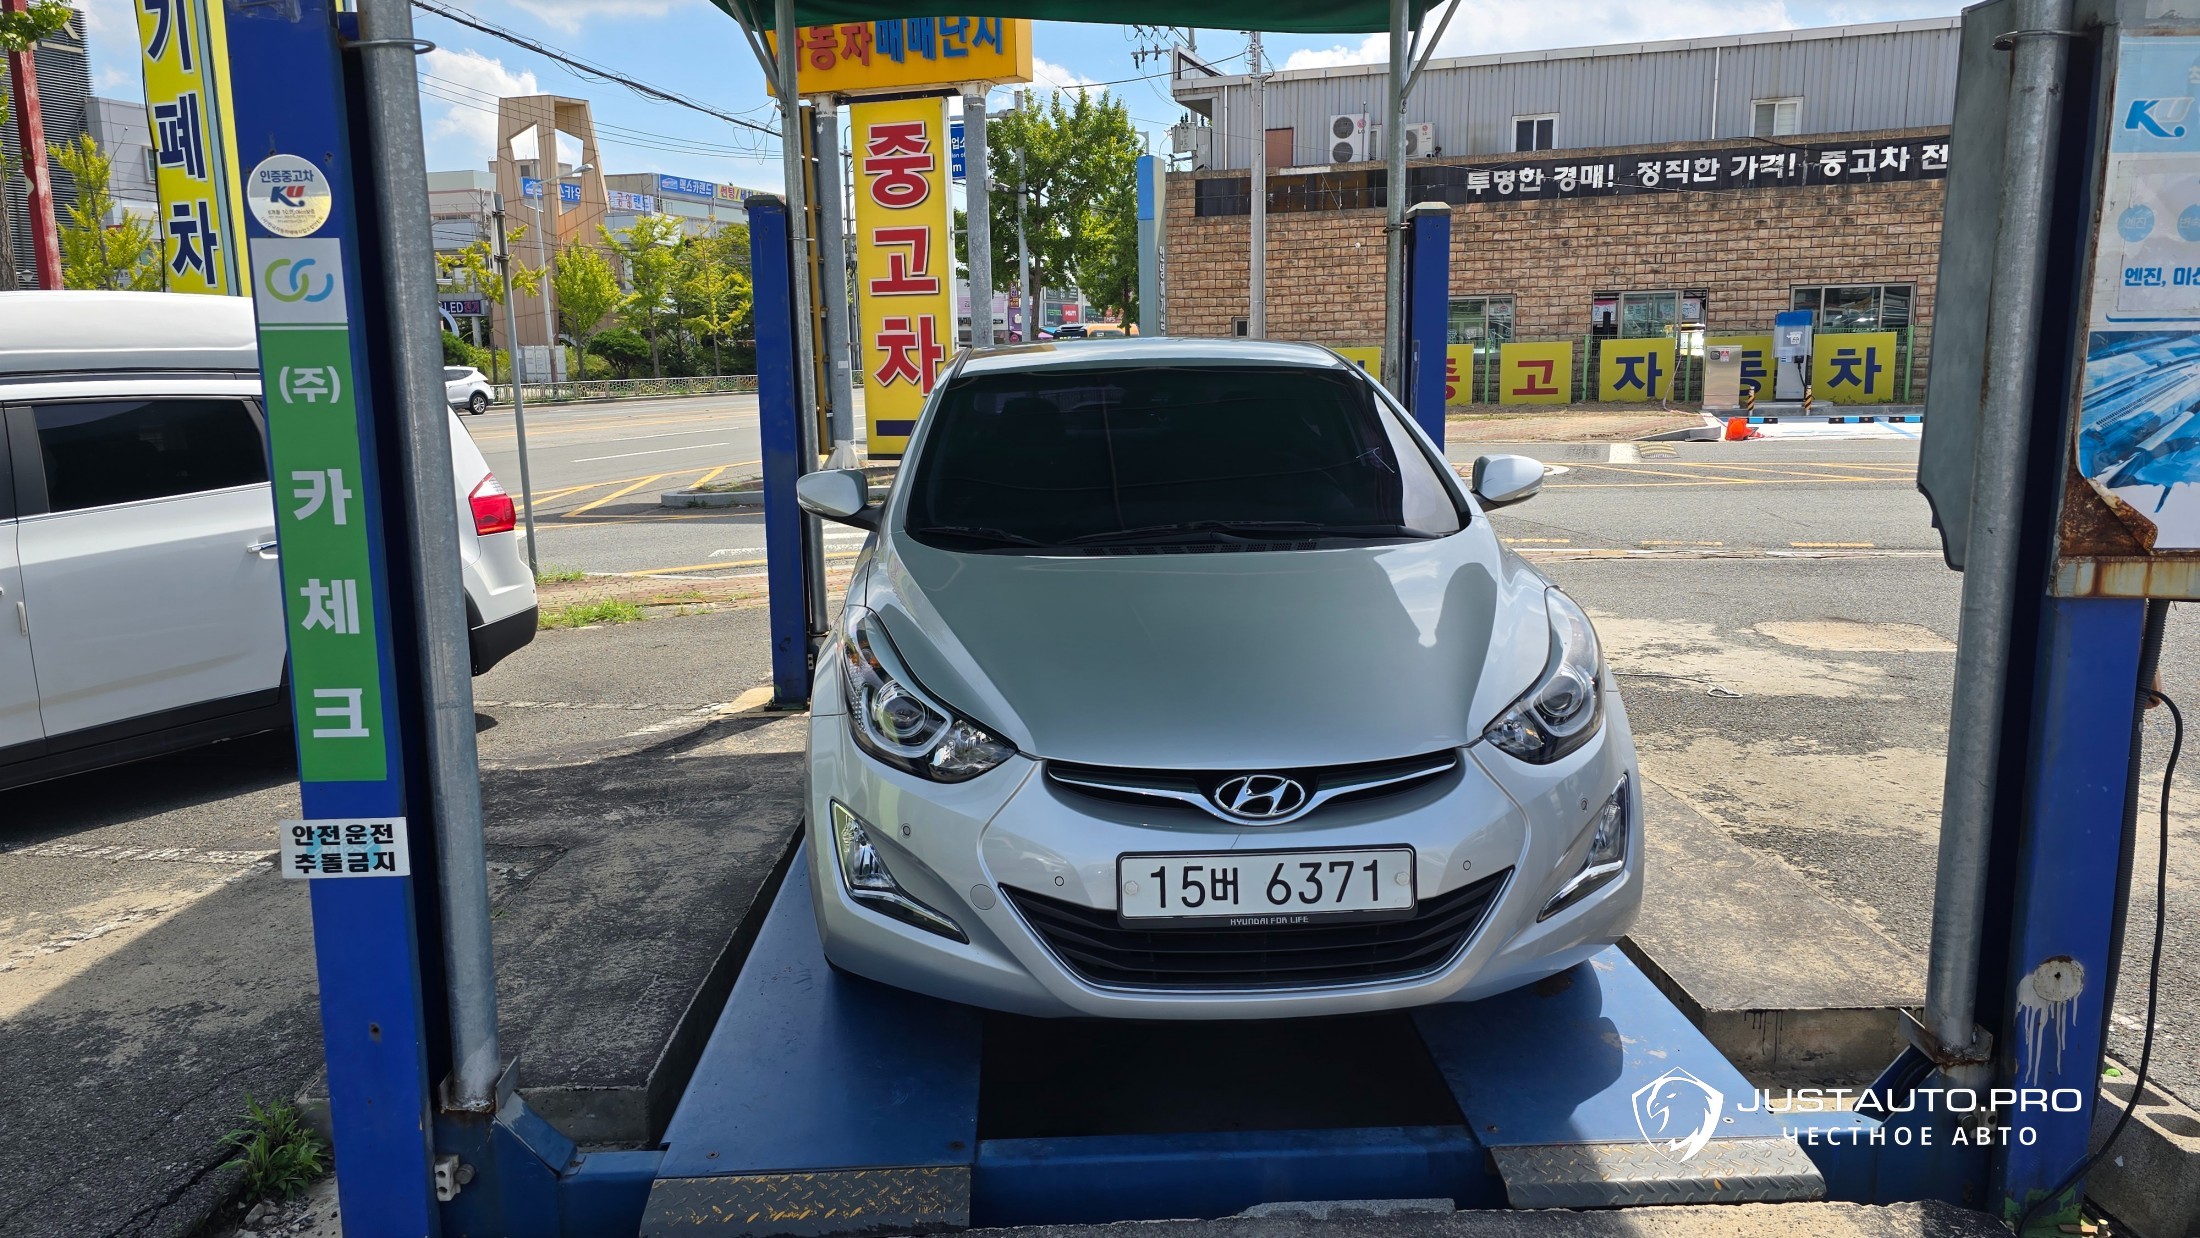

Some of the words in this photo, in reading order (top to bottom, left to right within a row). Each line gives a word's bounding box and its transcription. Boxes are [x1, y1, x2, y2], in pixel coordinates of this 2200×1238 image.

[259, 169, 315, 183] 인증중고차
[1467, 167, 1543, 195] 투명한
[1553, 163, 1614, 192] 경매!
[1637, 157, 1720, 186] 정직한
[1730, 152, 1797, 181] 가격!
[1820, 146, 1911, 177] 중고차
[864, 120, 944, 396] 중고차
[2124, 266, 2167, 288] 엔진,
[279, 365, 341, 404] (주)
[292, 824, 394, 846] 안전운전
[294, 851, 396, 874] 추돌금지
[1150, 865, 1239, 908] 15버
[1266, 859, 1379, 906] 6371
[1230, 917, 1268, 926] HYUNDAI
[1270, 916, 1288, 924] FOR
[1290, 915, 1309, 924] LIFE
